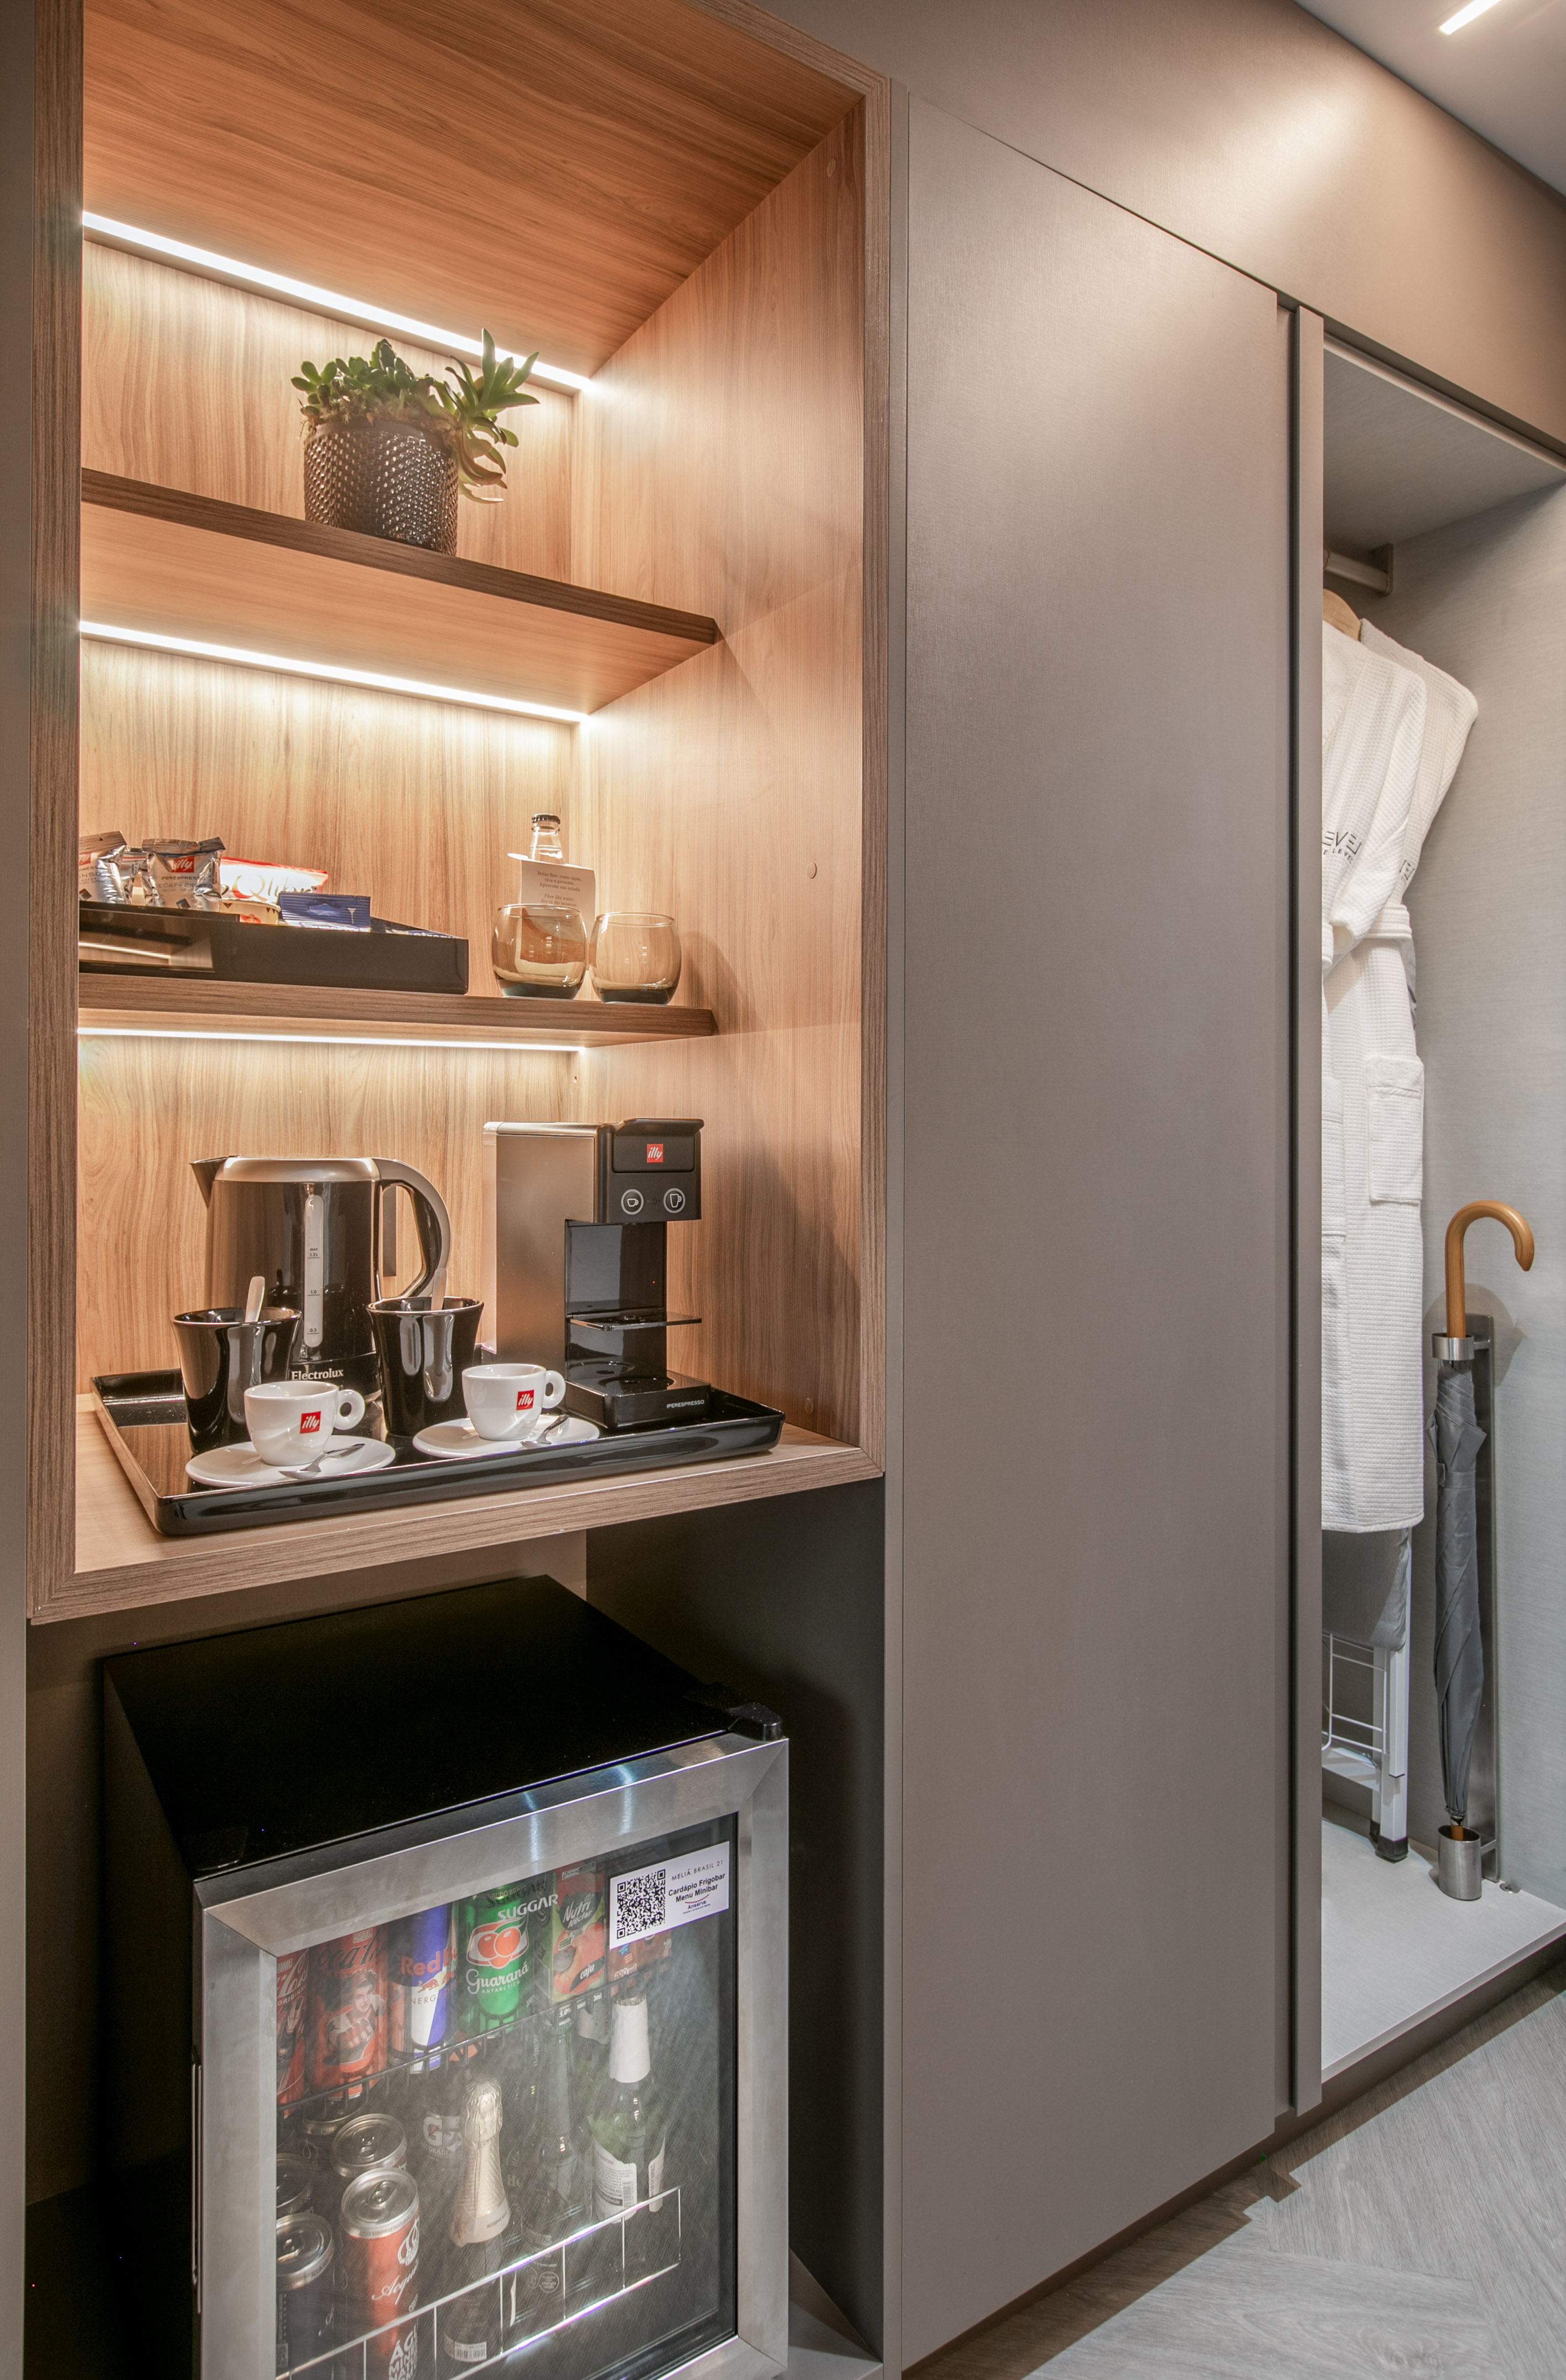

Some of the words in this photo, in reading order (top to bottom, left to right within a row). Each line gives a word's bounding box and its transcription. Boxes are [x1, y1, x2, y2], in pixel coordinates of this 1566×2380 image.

[648, 1147, 662, 1161] illy
[291, 1368, 344, 1381] Electrolux
[518, 1393, 533, 1409] illy
[666, 1399, 705, 1409] IPERESPRESSO
[302, 1415, 319, 1431] illy
[693, 1862, 714, 1874] BRASIL
[668, 1882, 697, 1896] Cardápio
[699, 1873, 725, 1887] Frigobar
[676, 1892, 693, 1903] Menu
[694, 1884, 718, 1897] Minibar
[497, 1893, 558, 1921] SUGGAR
[562, 1900, 592, 1924] Nutri
[687, 1900, 707, 1910] Anserve
[401, 1950, 440, 1977] Red
[465, 1960, 529, 1995] Guaraná
[580, 1964, 595, 1980] caju
[481, 1980, 520, 1994] ANTARCTICA
